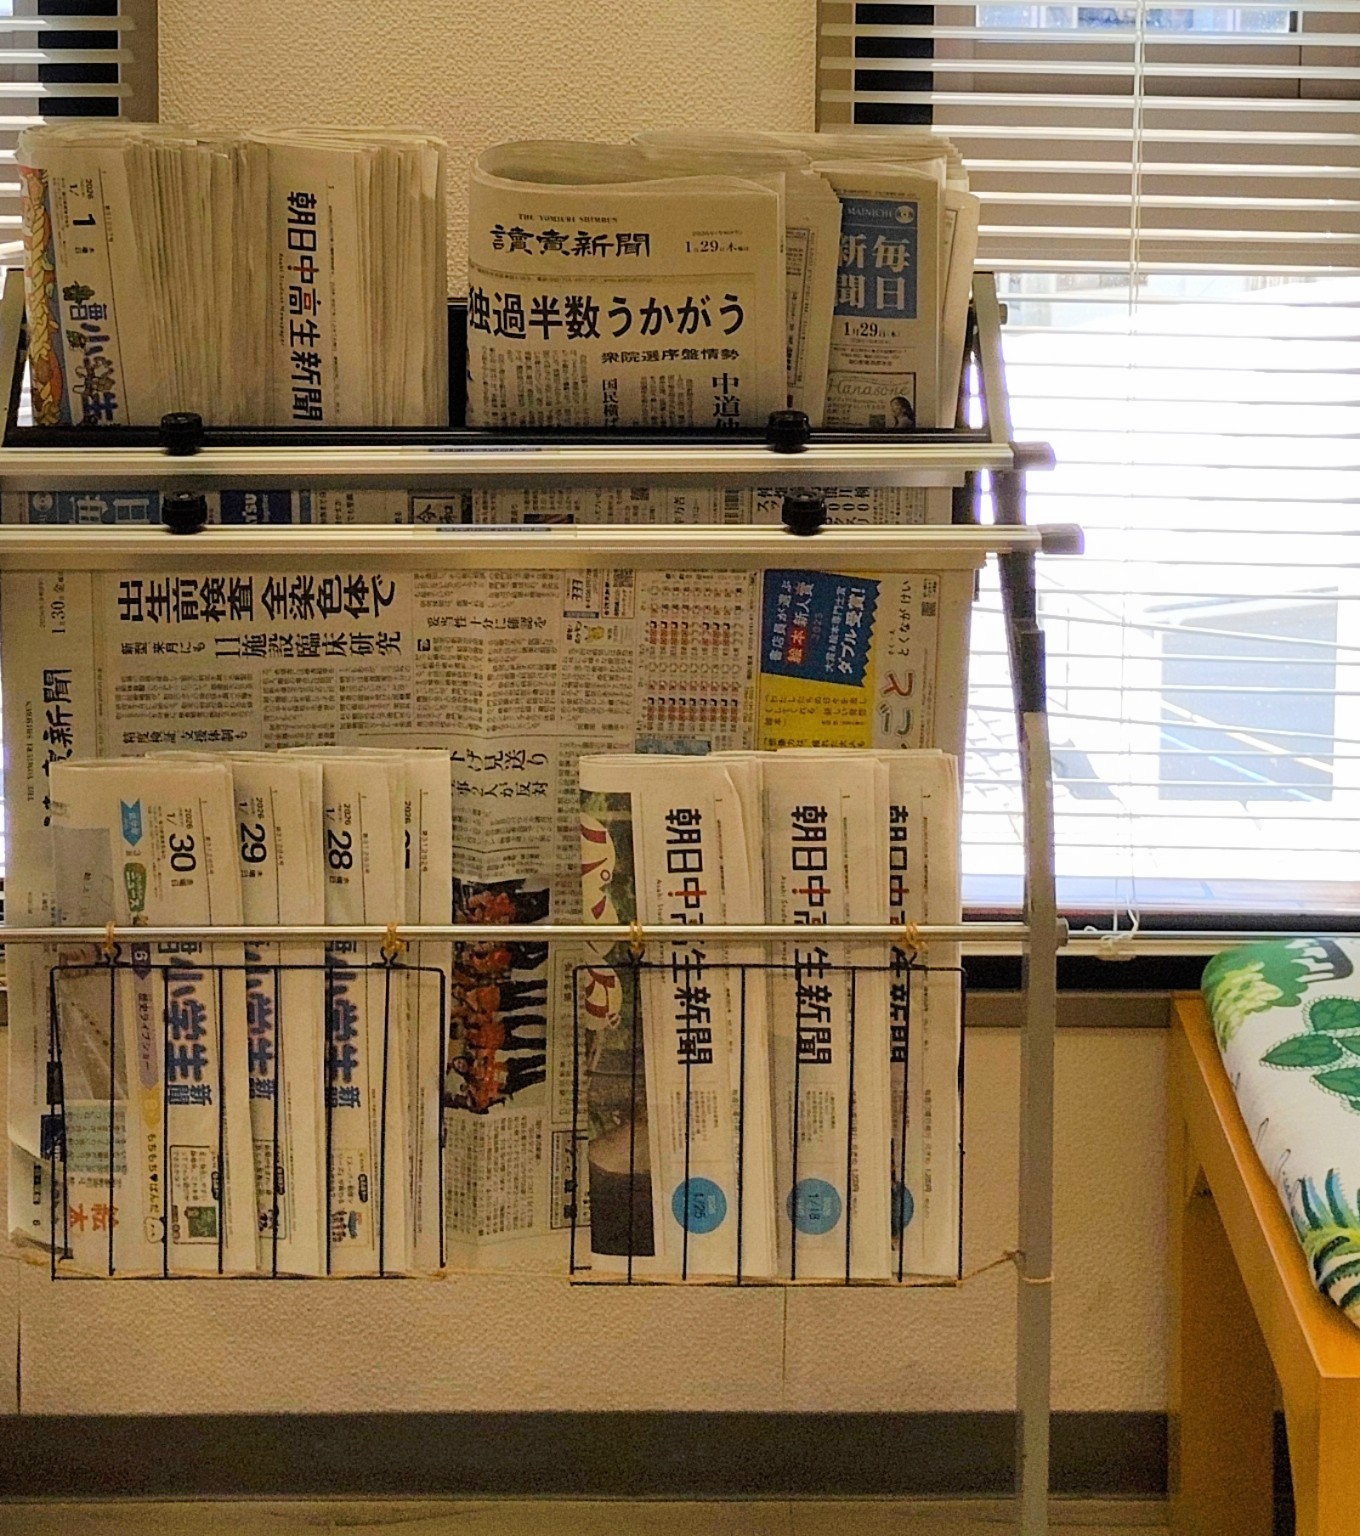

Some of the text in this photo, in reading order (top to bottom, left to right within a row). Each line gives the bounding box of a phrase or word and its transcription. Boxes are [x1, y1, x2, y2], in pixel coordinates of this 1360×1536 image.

[287, 191, 324, 421] 朝日中高生新聞
[602, 348, 740, 363] 衆院選序盤情勢
[118, 576, 253, 623] 出生前検査
[261, 574, 396, 620] 全染色体で
[769, 581, 793, 662] 書店員が選ぶ
[215, 631, 401, 658] 11施設臨床研究
[879, 672, 914, 749] ごと
[184, 808, 193, 830] 2026
[256, 797, 265, 819] 2026
[344, 803, 352, 825] 2026
[169, 833, 196, 872] 30
[240, 822, 267, 863] 29
[328, 829, 353, 870] 28
